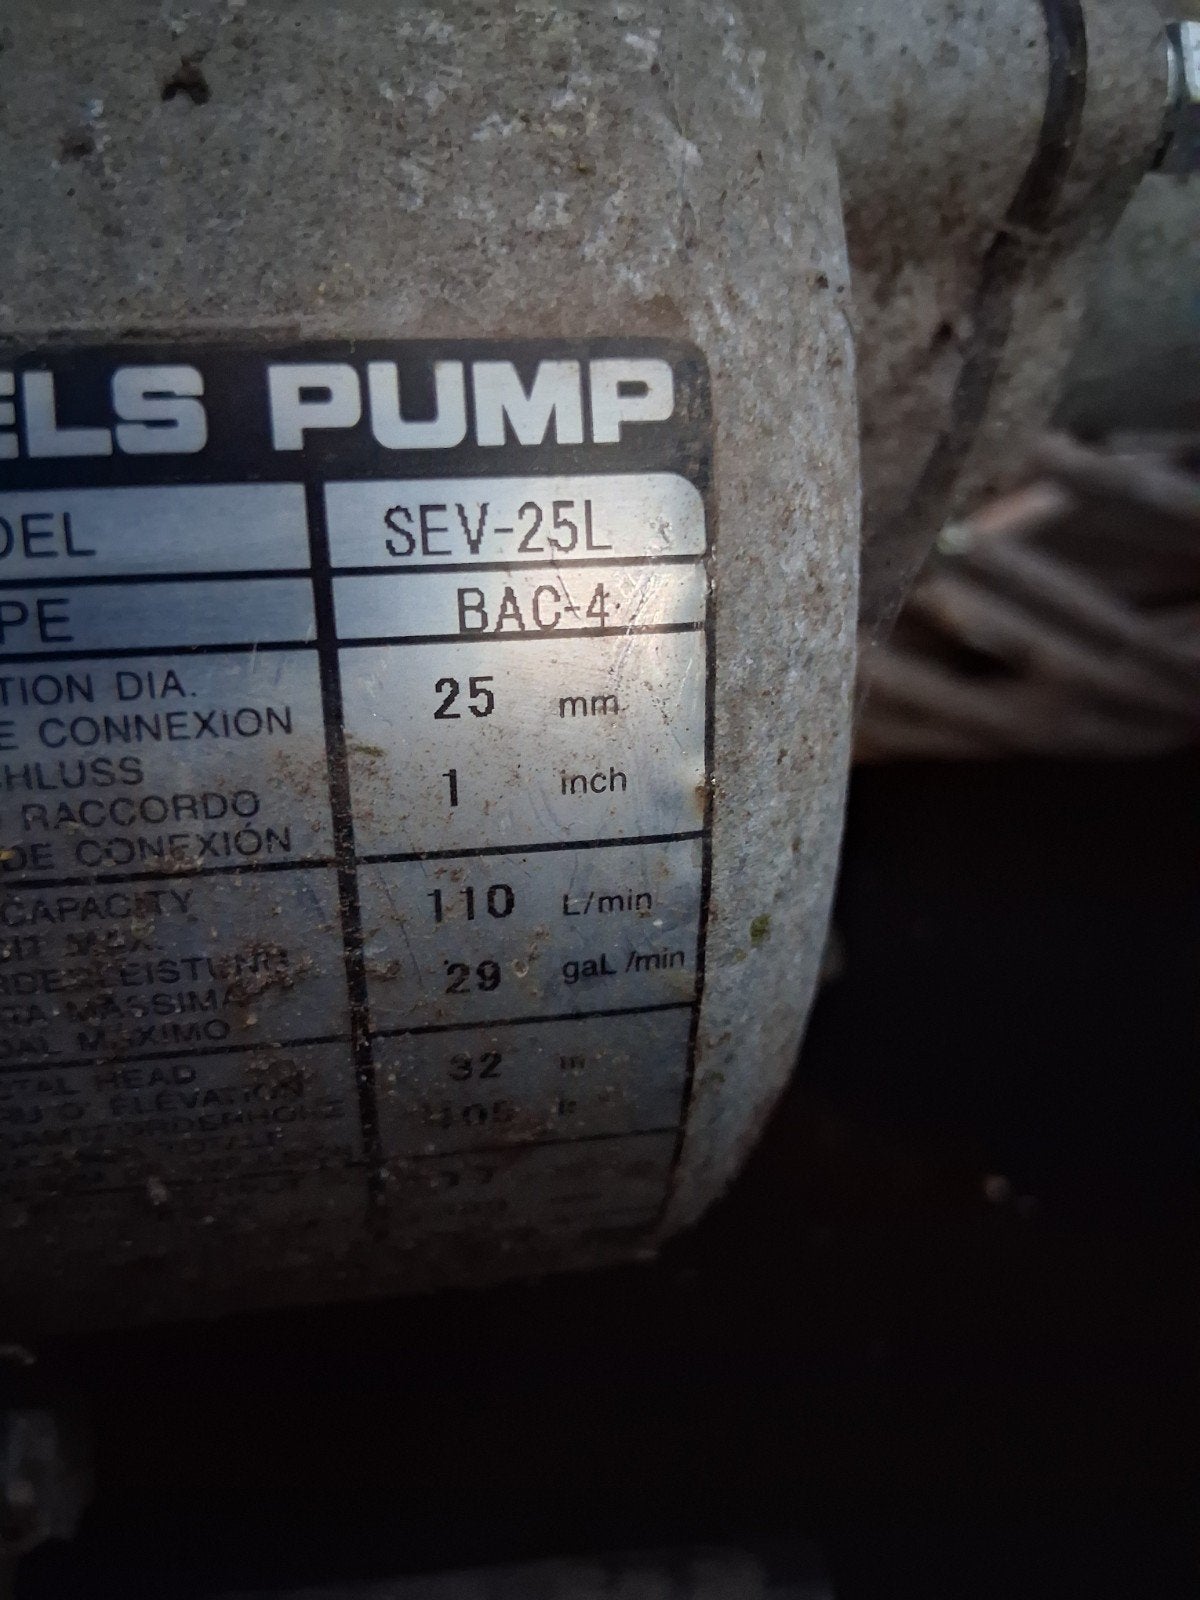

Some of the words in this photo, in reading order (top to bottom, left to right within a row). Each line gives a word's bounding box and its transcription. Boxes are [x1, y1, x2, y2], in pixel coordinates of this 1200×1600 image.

[0, 365, 208, 460] LS
[268, 357, 675, 451] PUMP
[384, 499, 613, 557] SEV-25L
[457, 582, 612, 634] BAC-4
[115, 669, 197, 701] DIA.
[433, 675, 495, 720] 25
[558, 694, 622, 718] mm
[38, 706, 293, 749] CONNEXION
[0, 756, 145, 791] HLUSS
[442, 768, 459, 807] 1
[561, 766, 628, 796] inch
[21, 789, 260, 831] RACCORDO
[427, 883, 516, 923] 110
[562, 889, 653, 917] L/min
[446, 960, 501, 994] 29
[77, 1018, 232, 1052] MXIMO
[448, 1052, 501, 1081] 32
